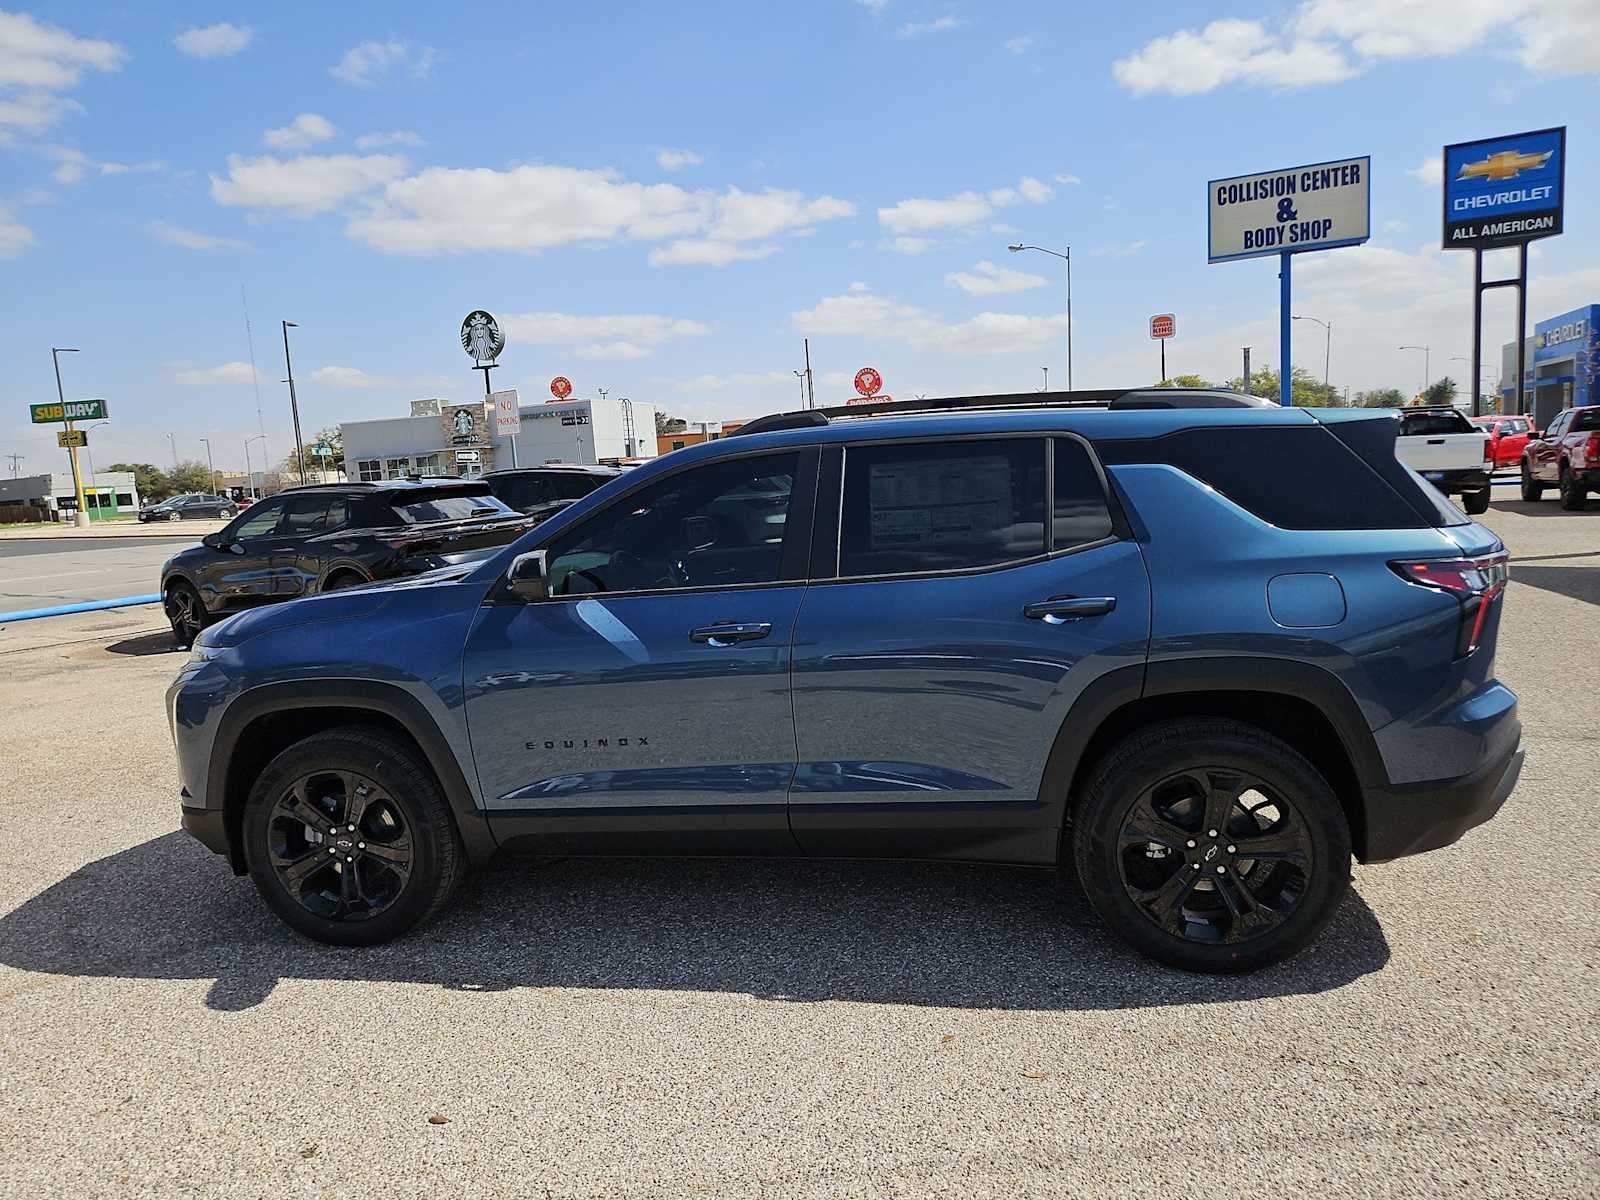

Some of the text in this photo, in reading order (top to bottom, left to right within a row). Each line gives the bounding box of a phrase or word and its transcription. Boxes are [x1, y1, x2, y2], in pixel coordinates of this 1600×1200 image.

[1217, 164, 1360, 206] COLLISION CENTER
[1276, 197, 1298, 223] &
[1454, 185, 1552, 211] CHEVROLET
[1244, 218, 1332, 249] BODY SHOP
[1453, 215, 1554, 240] ALL AMERICAN
[1546, 319, 1585, 346] CHEVROLET
[35, 403, 98, 420] SUBWAY
[500, 400, 512, 411] NO
[496, 416, 519, 425] PARKING
[525, 735, 649, 750] EQUINOX
